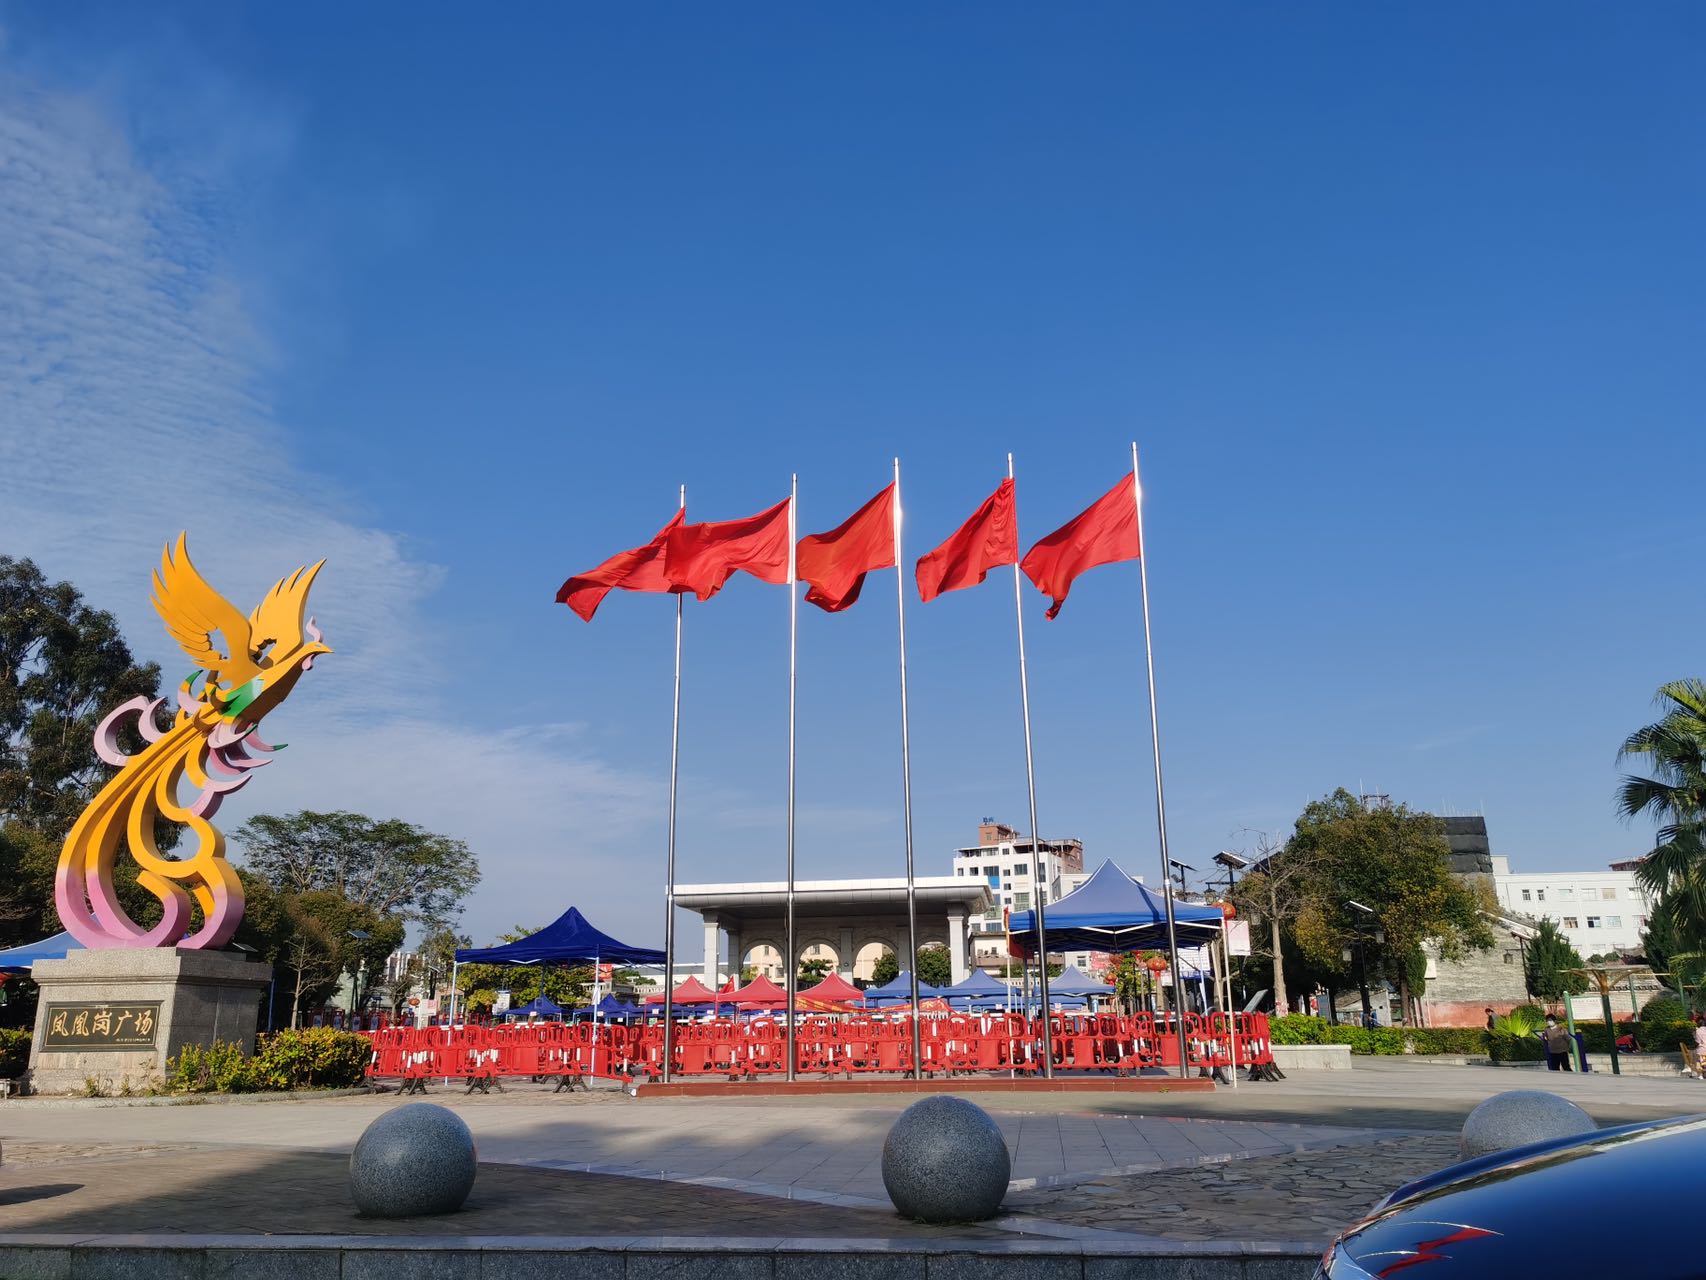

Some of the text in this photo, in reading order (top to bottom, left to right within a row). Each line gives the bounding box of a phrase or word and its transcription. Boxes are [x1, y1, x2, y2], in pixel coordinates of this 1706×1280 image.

[50, 1009, 154, 1037] 凤凰岗广场
